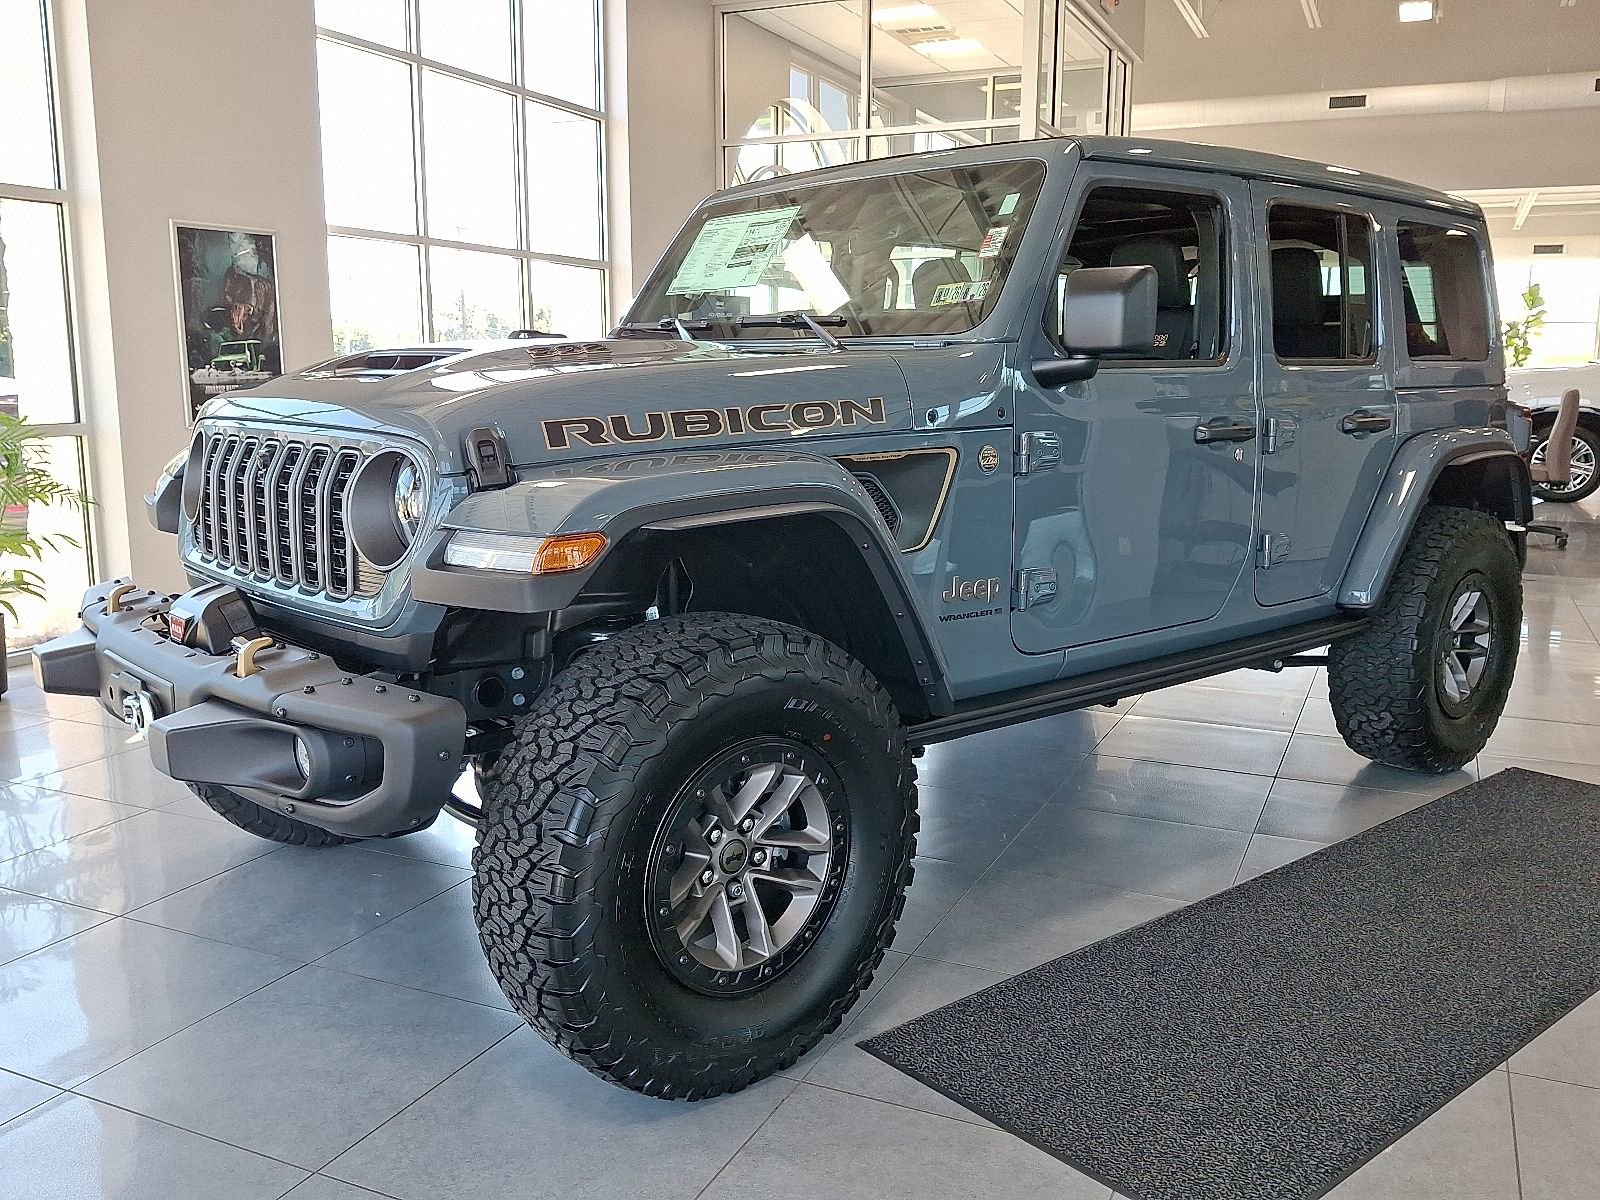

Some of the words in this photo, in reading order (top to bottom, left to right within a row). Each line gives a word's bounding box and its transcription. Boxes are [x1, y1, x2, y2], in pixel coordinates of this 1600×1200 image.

[540, 397, 886, 450] RUBICON
[942, 575, 1000, 604] Jeep
[939, 609, 993, 622] WRANGLER
